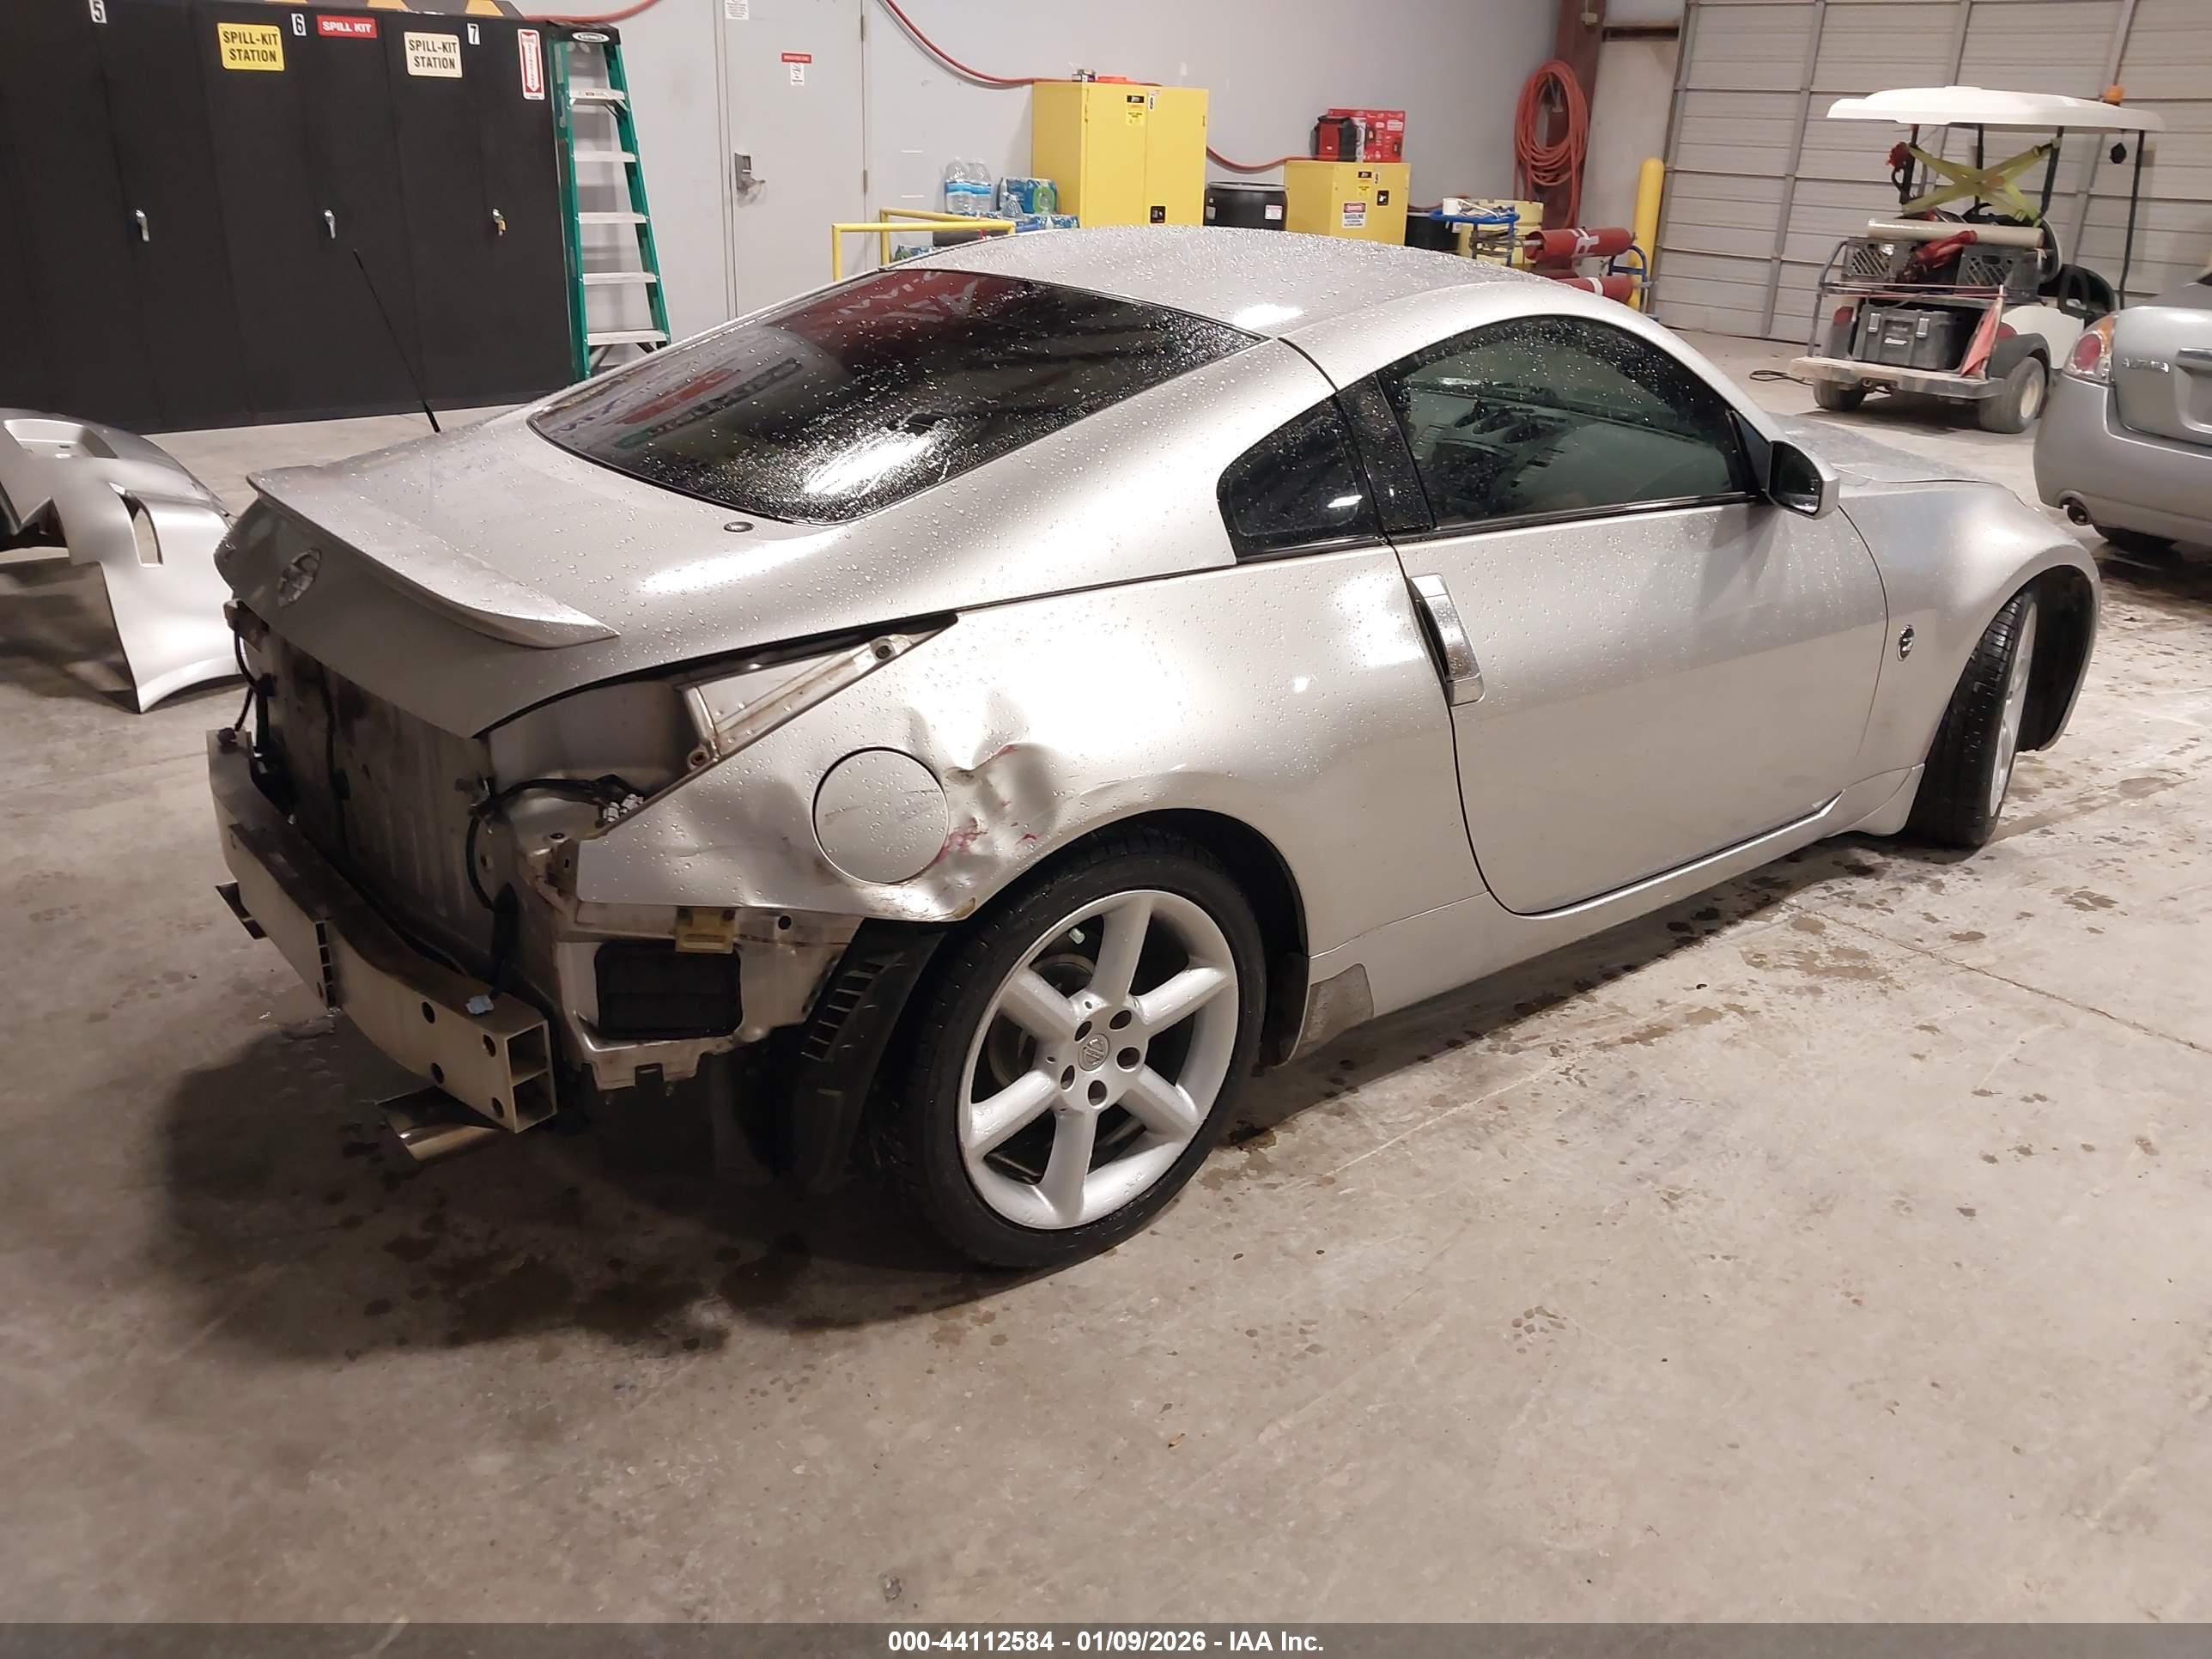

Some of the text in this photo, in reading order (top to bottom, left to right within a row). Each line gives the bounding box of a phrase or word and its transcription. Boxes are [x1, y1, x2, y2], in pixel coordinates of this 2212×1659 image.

[93, 1, 104, 21] 5
[294, 15, 304, 34] 6
[322, 21, 372, 33] SPILL KIT
[222, 30, 278, 46] SPILL-KIT
[470, 25, 477, 43] 7
[409, 40, 458, 54] SPILL-KIT
[229, 48, 277, 63] STATION
[414, 56, 456, 70] STATION
